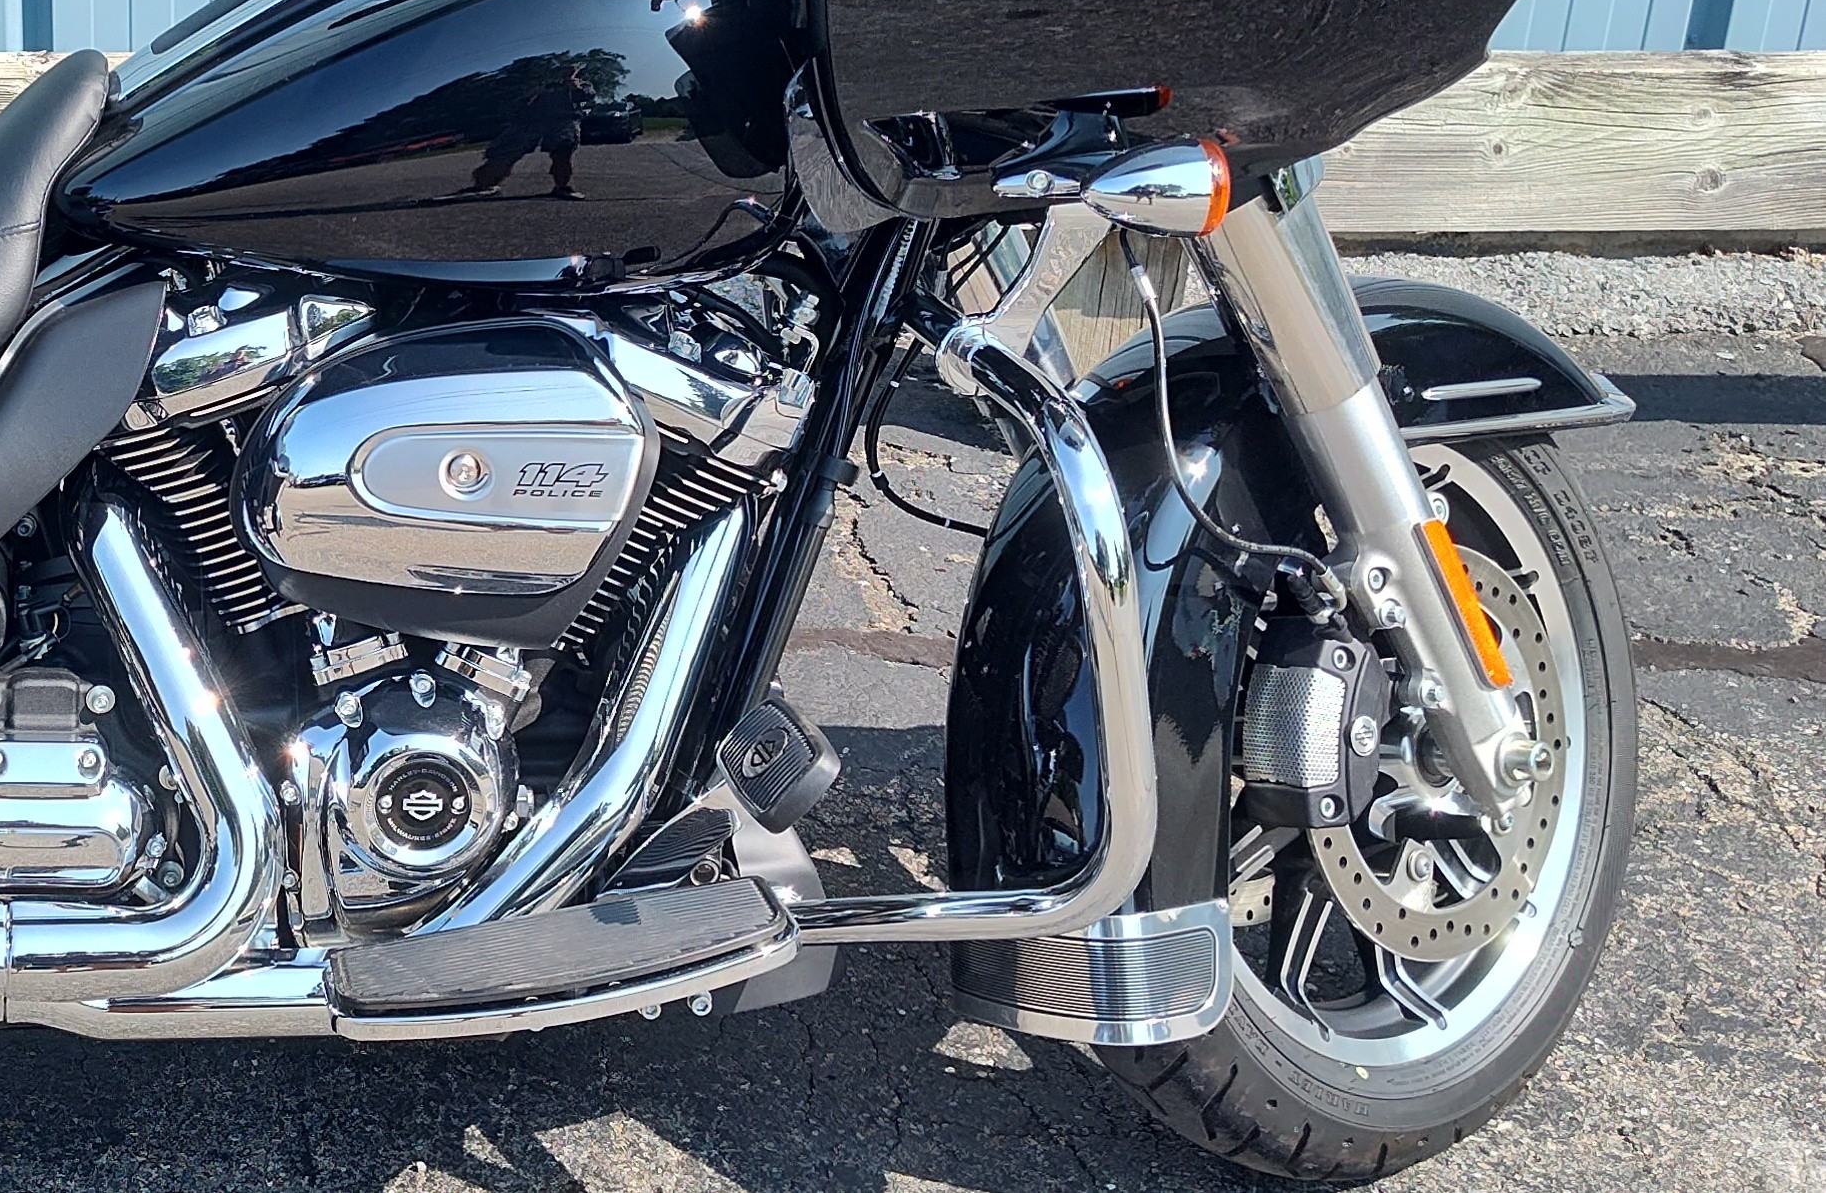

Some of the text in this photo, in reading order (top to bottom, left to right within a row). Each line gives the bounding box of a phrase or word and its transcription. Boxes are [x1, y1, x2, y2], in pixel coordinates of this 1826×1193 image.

[516, 462, 610, 488] 114
[512, 488, 604, 498] POLICE
[387, 768, 458, 793] HARLEY-DAVIDSON
[1288, 1071, 1370, 1117] HARLEY
